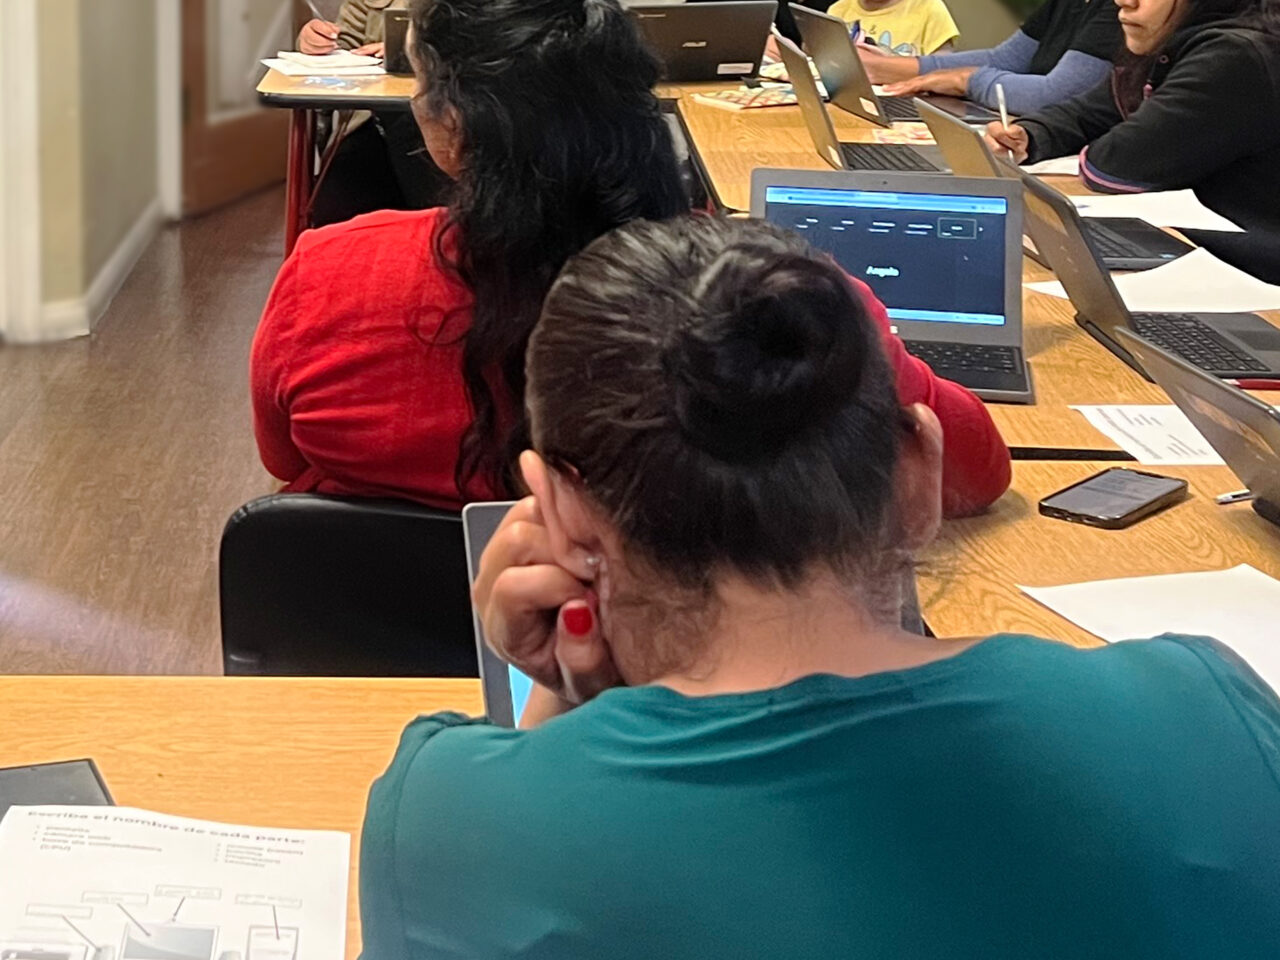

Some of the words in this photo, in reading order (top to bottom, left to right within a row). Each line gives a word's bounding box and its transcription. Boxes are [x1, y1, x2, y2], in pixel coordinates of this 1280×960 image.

[28, 811, 88, 819] Escriba
[113, 816, 179, 830] nombre
[210, 830, 250, 839] cada
